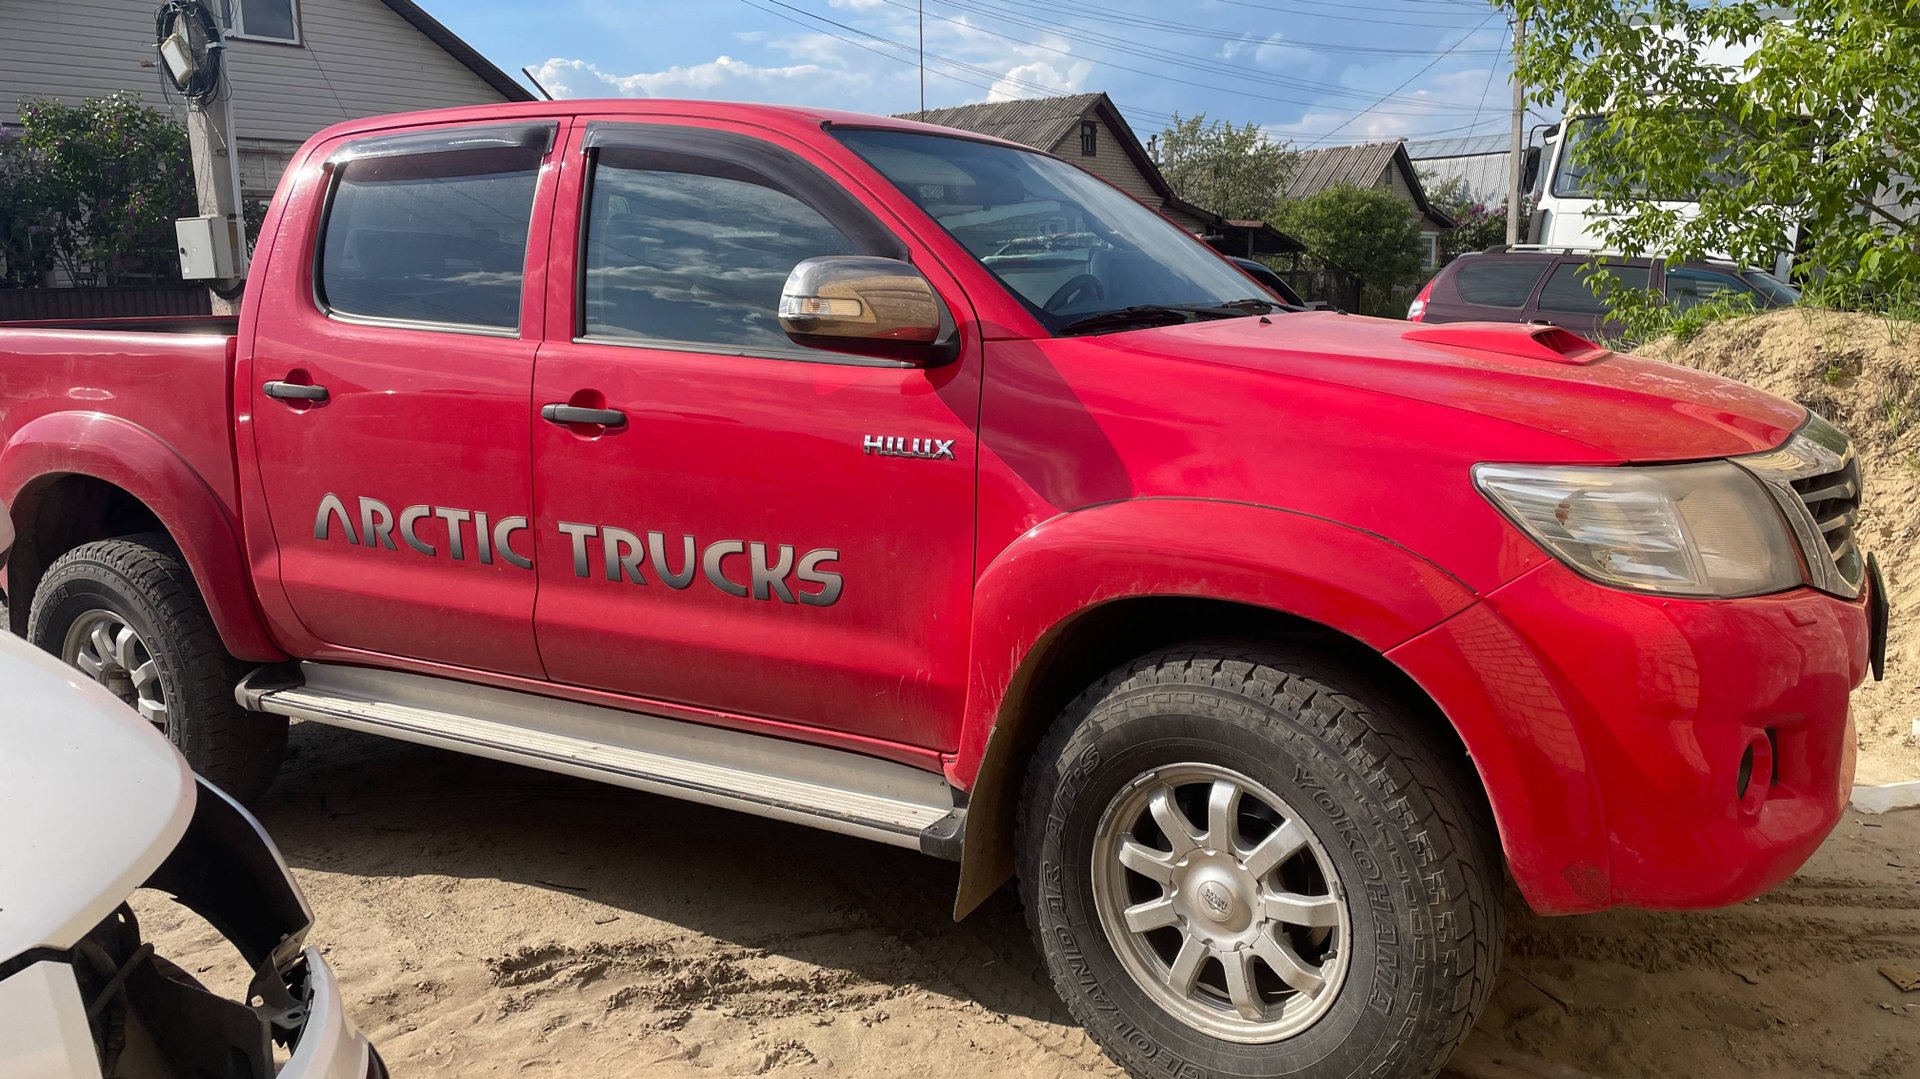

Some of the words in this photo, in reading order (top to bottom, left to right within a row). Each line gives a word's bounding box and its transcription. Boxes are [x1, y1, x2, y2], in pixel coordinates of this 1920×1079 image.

[864, 434, 955, 459] HILUX
[314, 492, 533, 570] ARCTIC
[558, 520, 844, 608] TRUCKS
[1042, 860, 1209, 1079] GEOLANDAR
[1291, 763, 1401, 1017] YOKOHAMA
